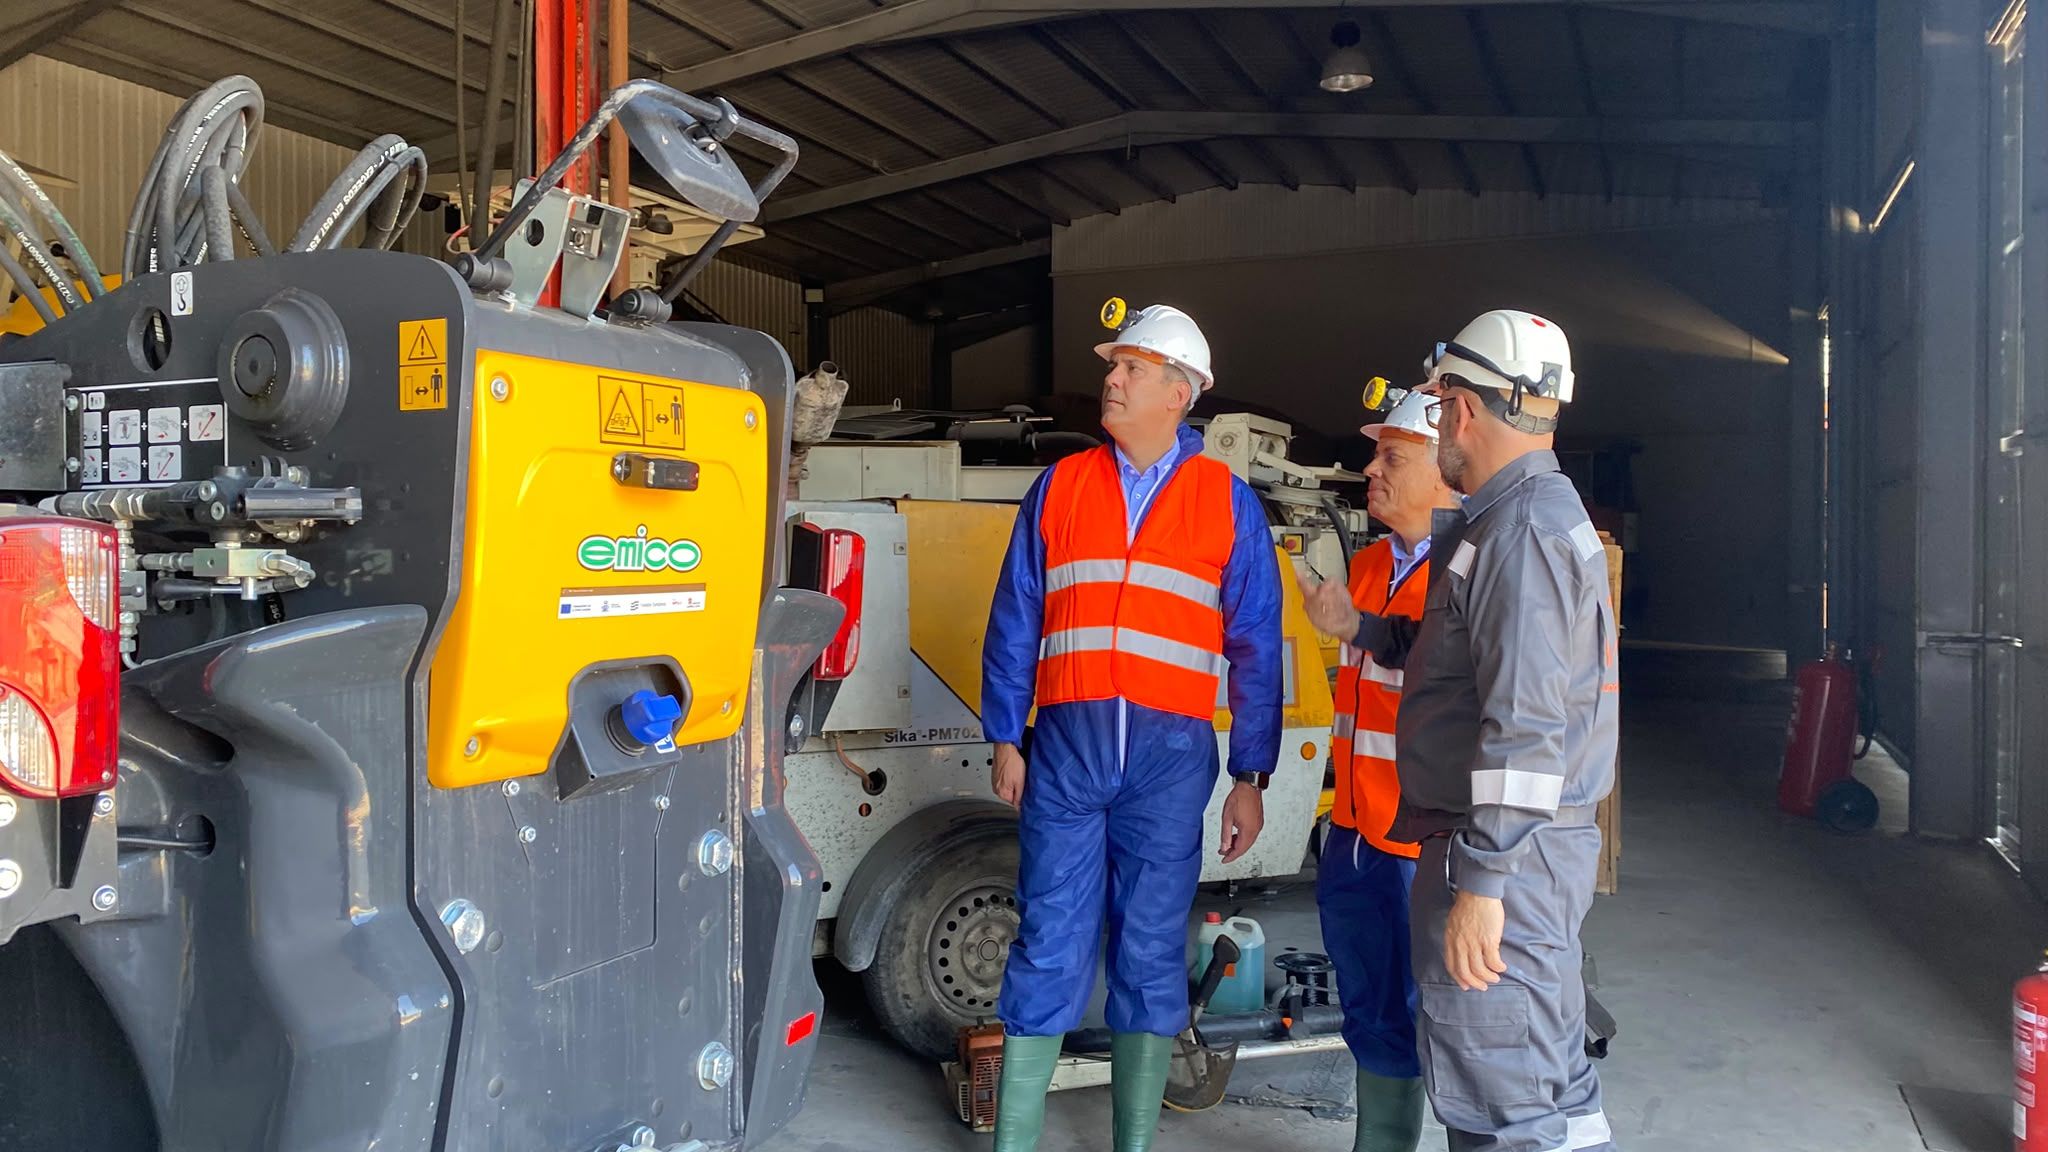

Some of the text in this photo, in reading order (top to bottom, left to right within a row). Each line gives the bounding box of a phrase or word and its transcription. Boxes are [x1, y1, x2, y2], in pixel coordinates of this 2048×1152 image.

[343, 166, 374, 205] EXCEEDS
[333, 202, 344, 219] EN
[44, 264, 60, 284] BAR
[578, 524, 701, 571] emico
